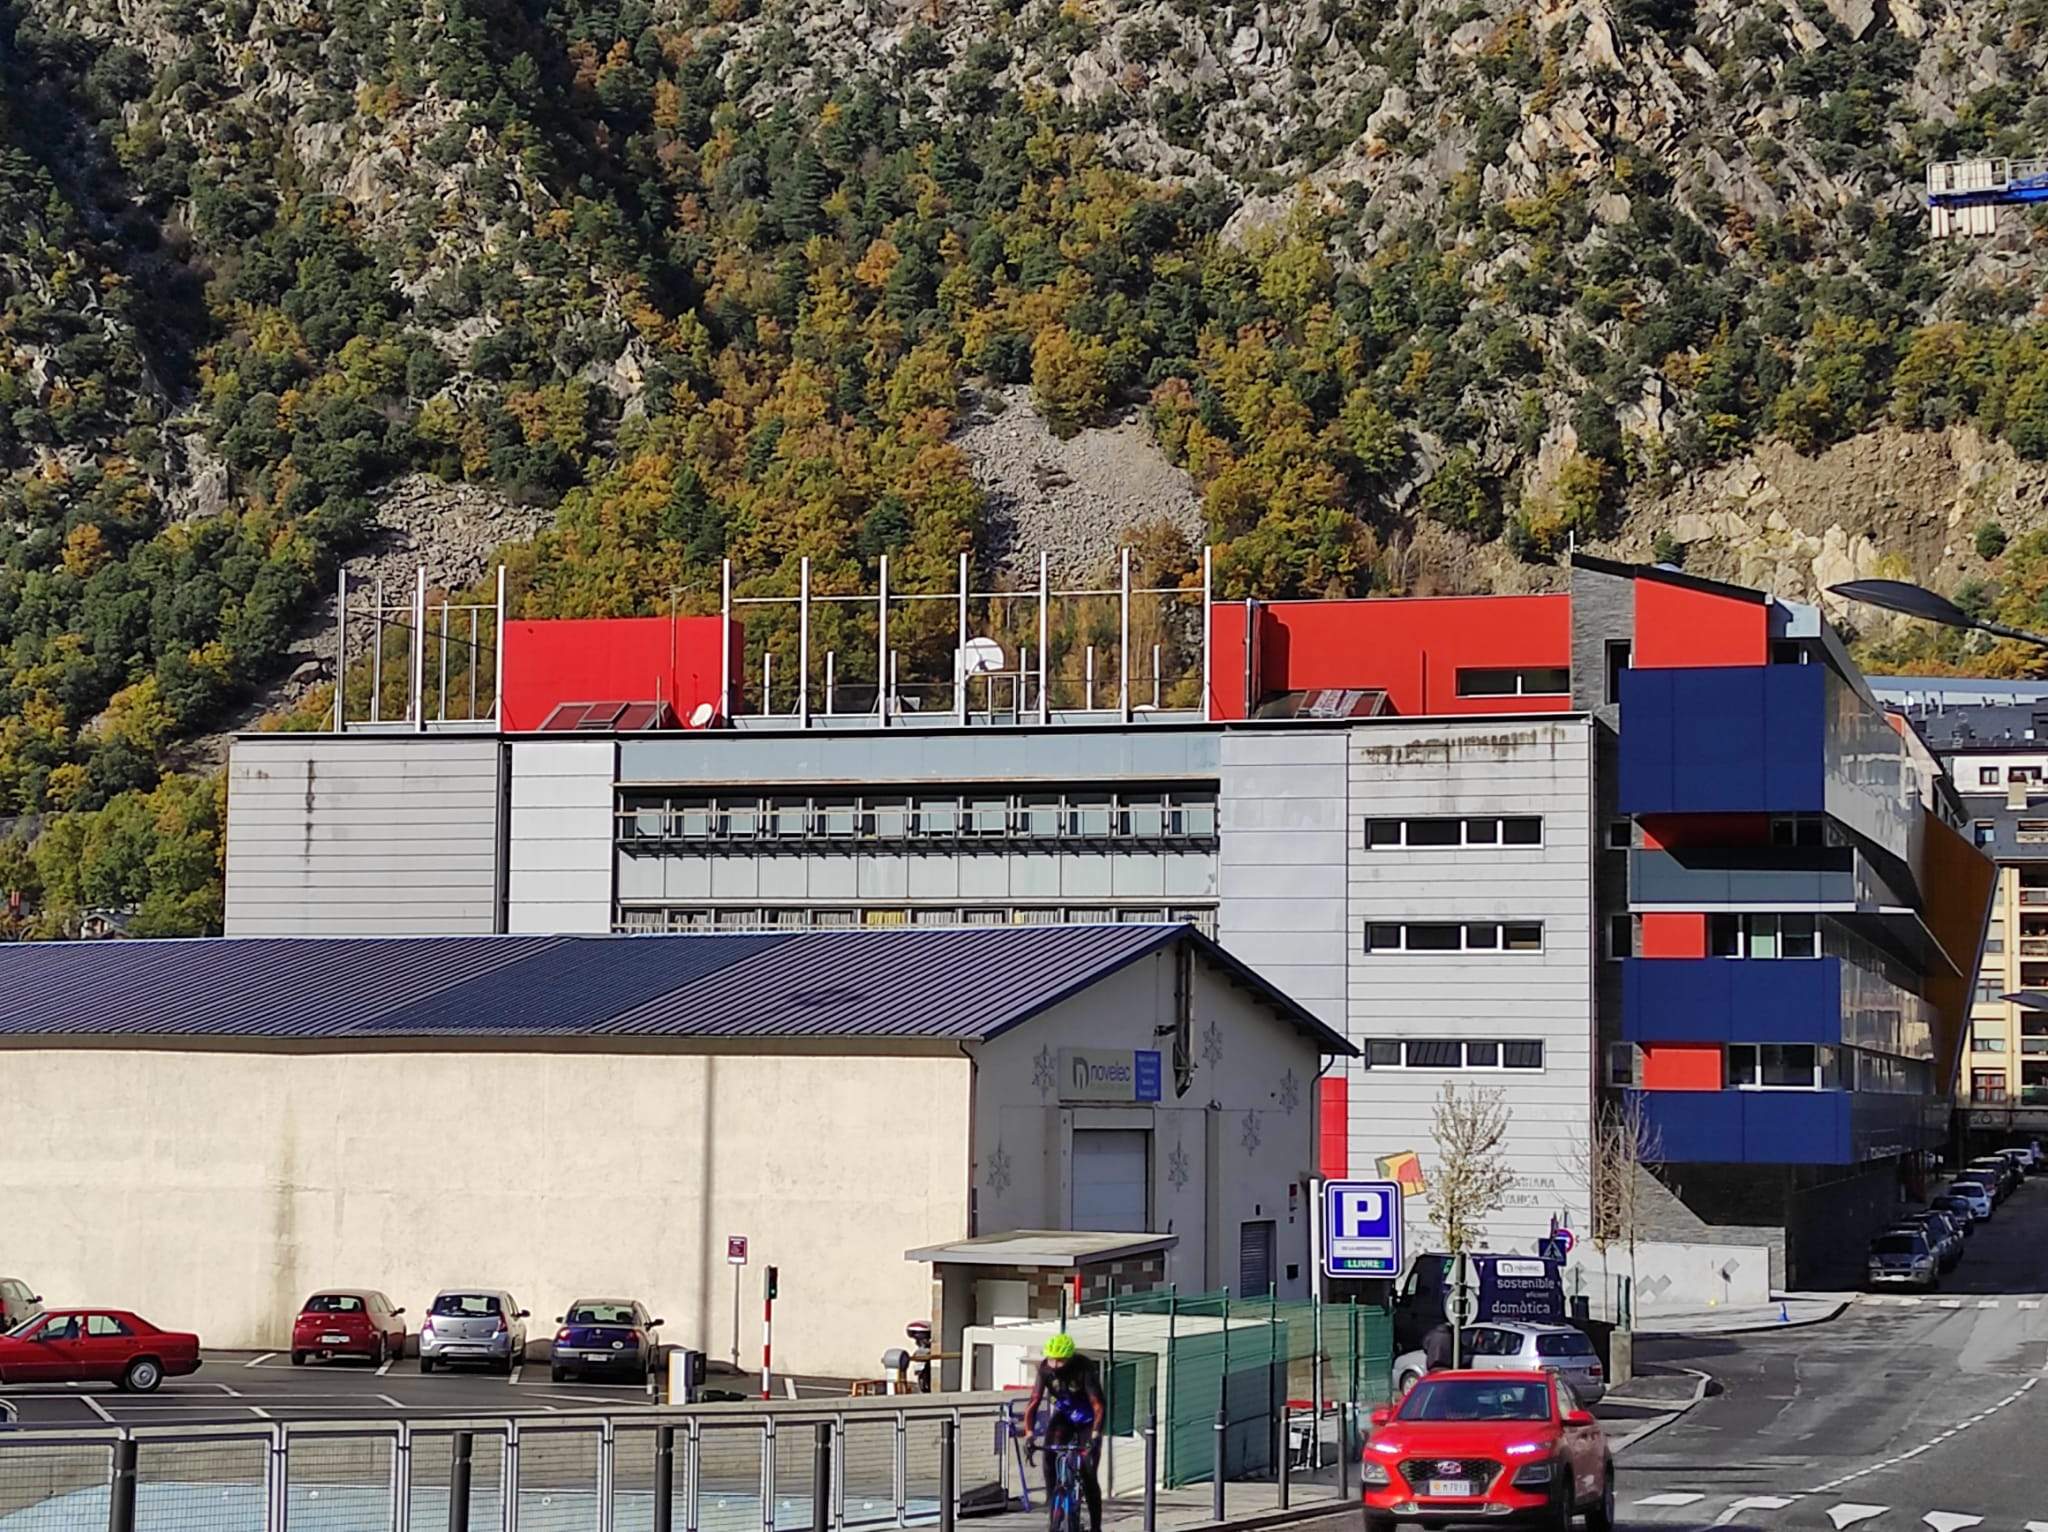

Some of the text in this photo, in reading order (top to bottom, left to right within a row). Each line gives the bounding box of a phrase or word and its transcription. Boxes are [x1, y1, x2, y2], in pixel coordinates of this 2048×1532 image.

[1090, 1061, 1130, 1081] novelec
[1343, 1192, 1382, 1237] P
[1347, 1260, 1379, 1268] LLIURE
[1497, 1278, 1555, 1289] sostenible
[1491, 1301, 1551, 1314] domòtica
